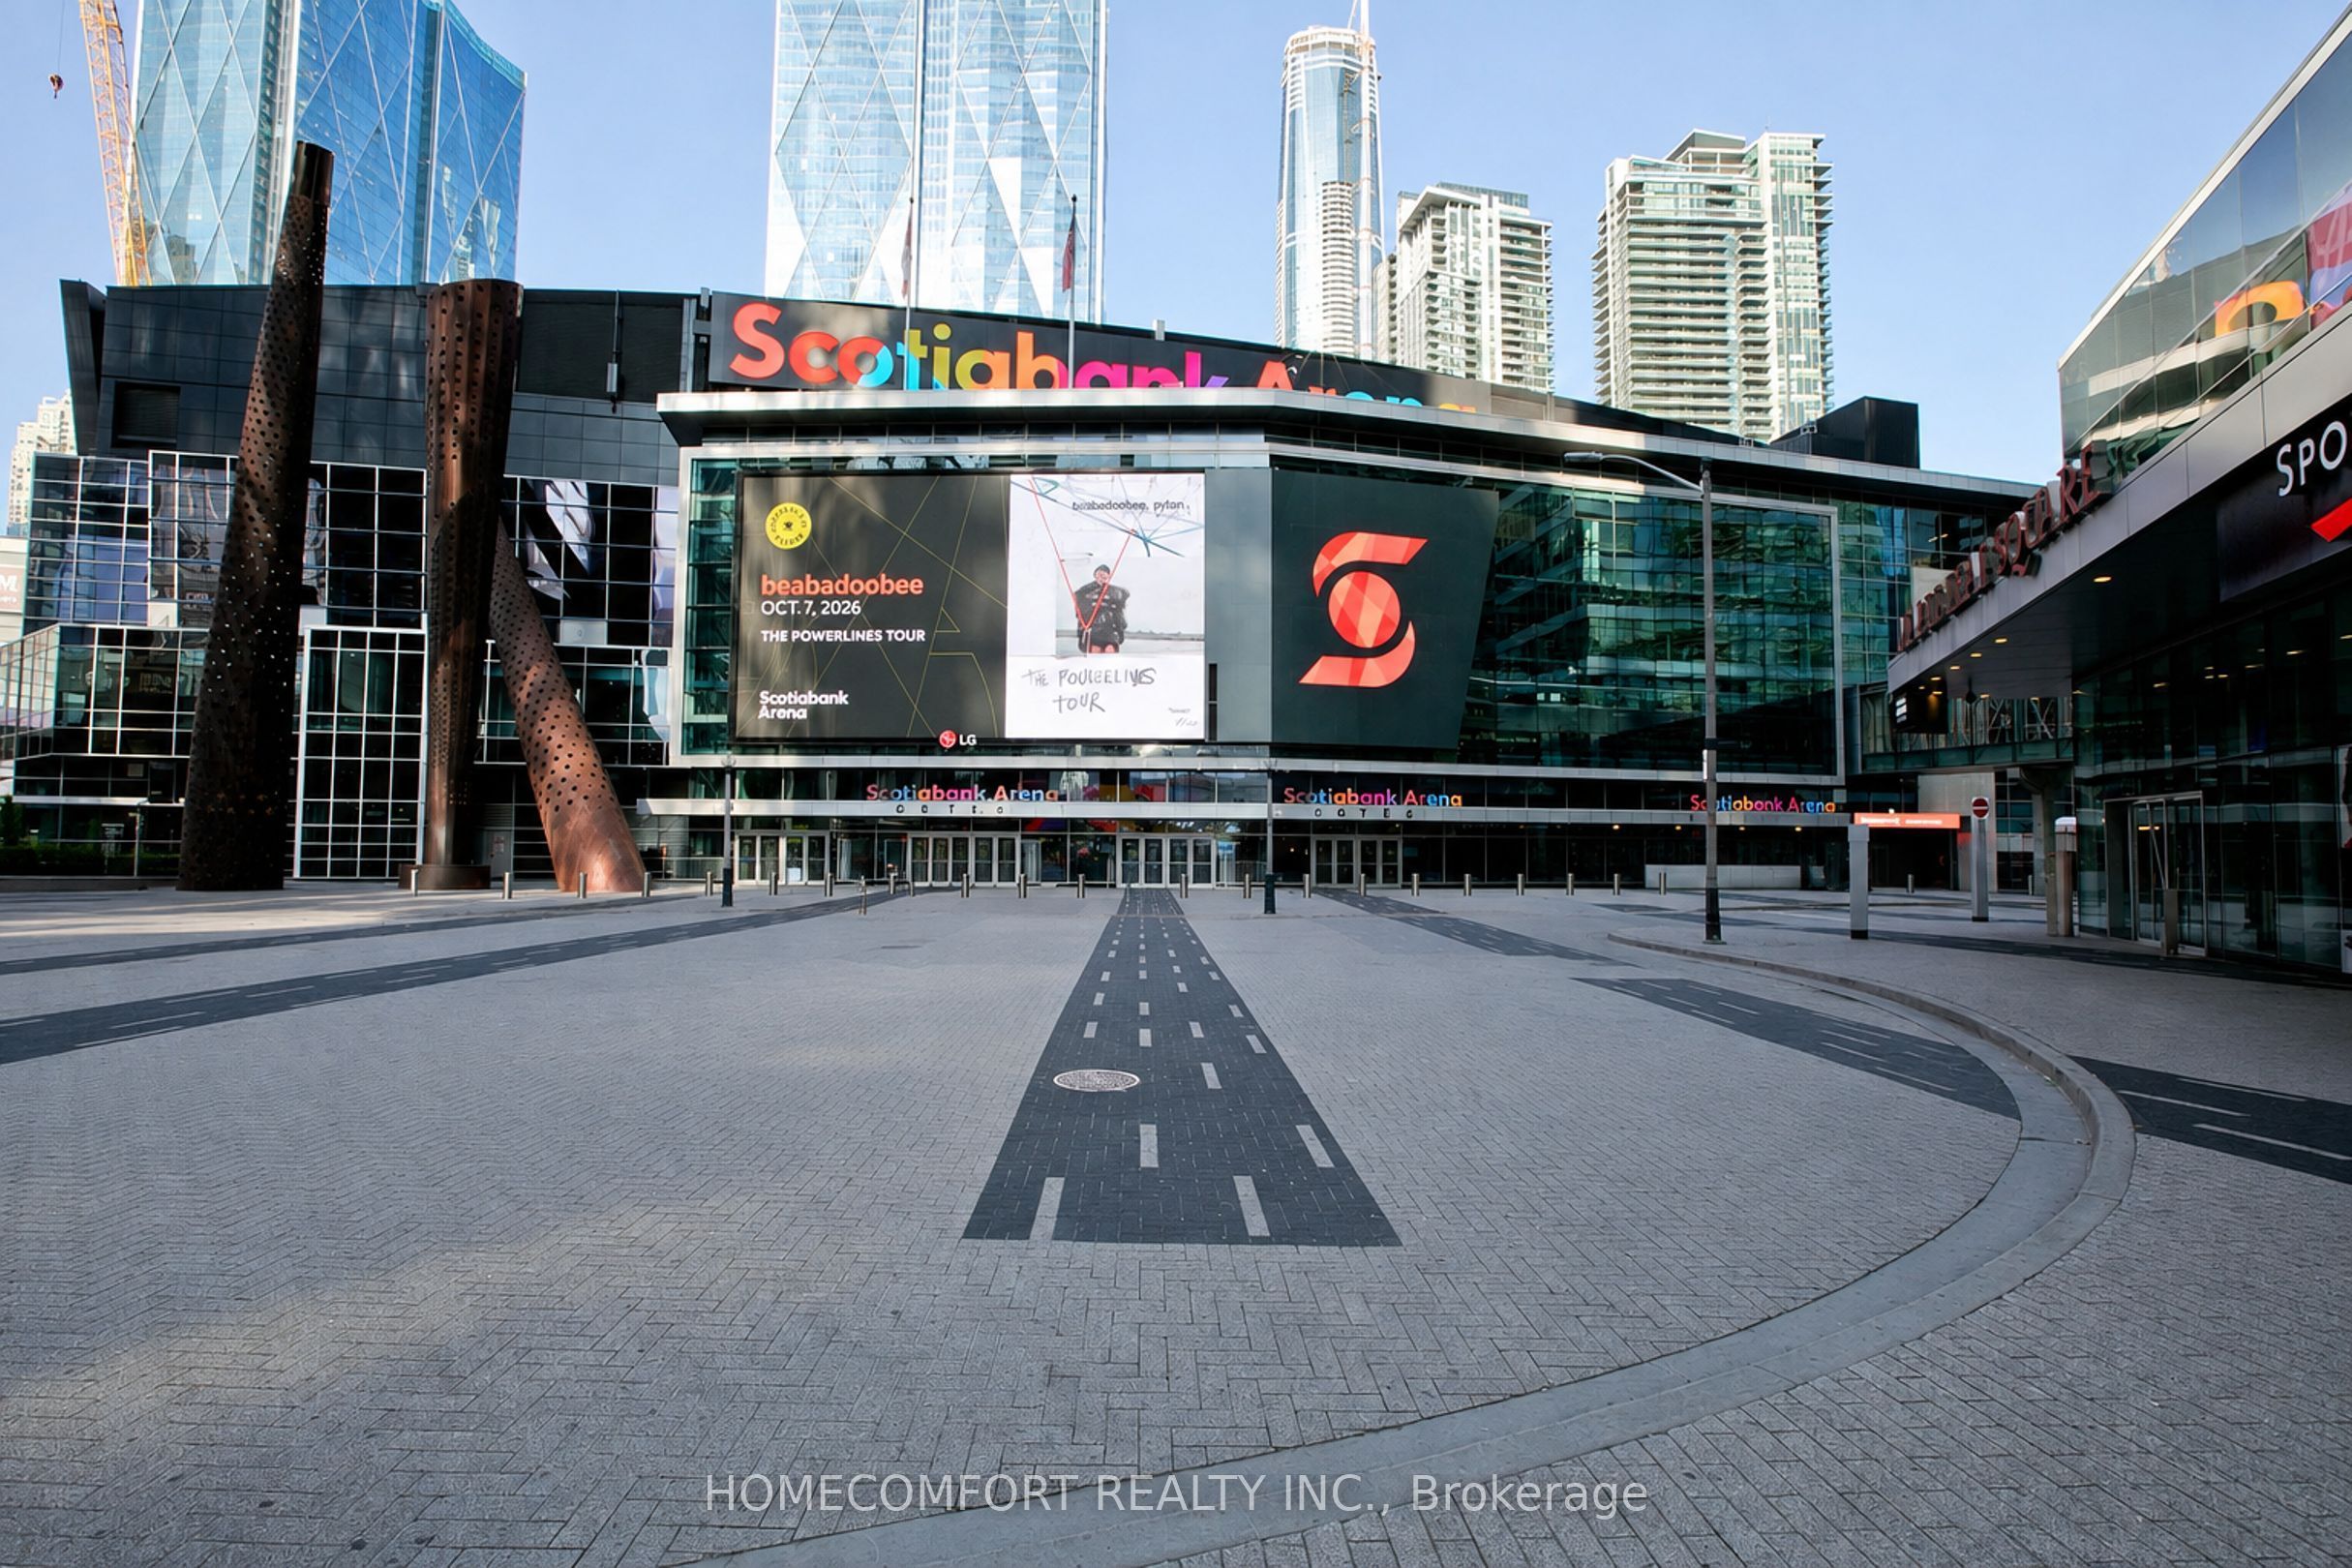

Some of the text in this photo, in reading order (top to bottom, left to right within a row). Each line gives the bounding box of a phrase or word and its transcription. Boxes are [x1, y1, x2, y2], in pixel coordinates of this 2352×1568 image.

[761, 573, 923, 595] beabadoobee
[761, 600, 861, 617] OCT. 7, 2026
[761, 630, 925, 642] THE POWERLINES TOUR
[759, 690, 849, 705] Scotiabank
[1052, 692, 1106, 713] TOUR
[758, 706, 807, 719] Arena
[959, 734, 977, 745] LG
[866, 783, 1059, 801] Scotiabank Arena
[1283, 787, 1462, 807] Scotiabank Arena
[1786, 796, 1836, 814] Arena
